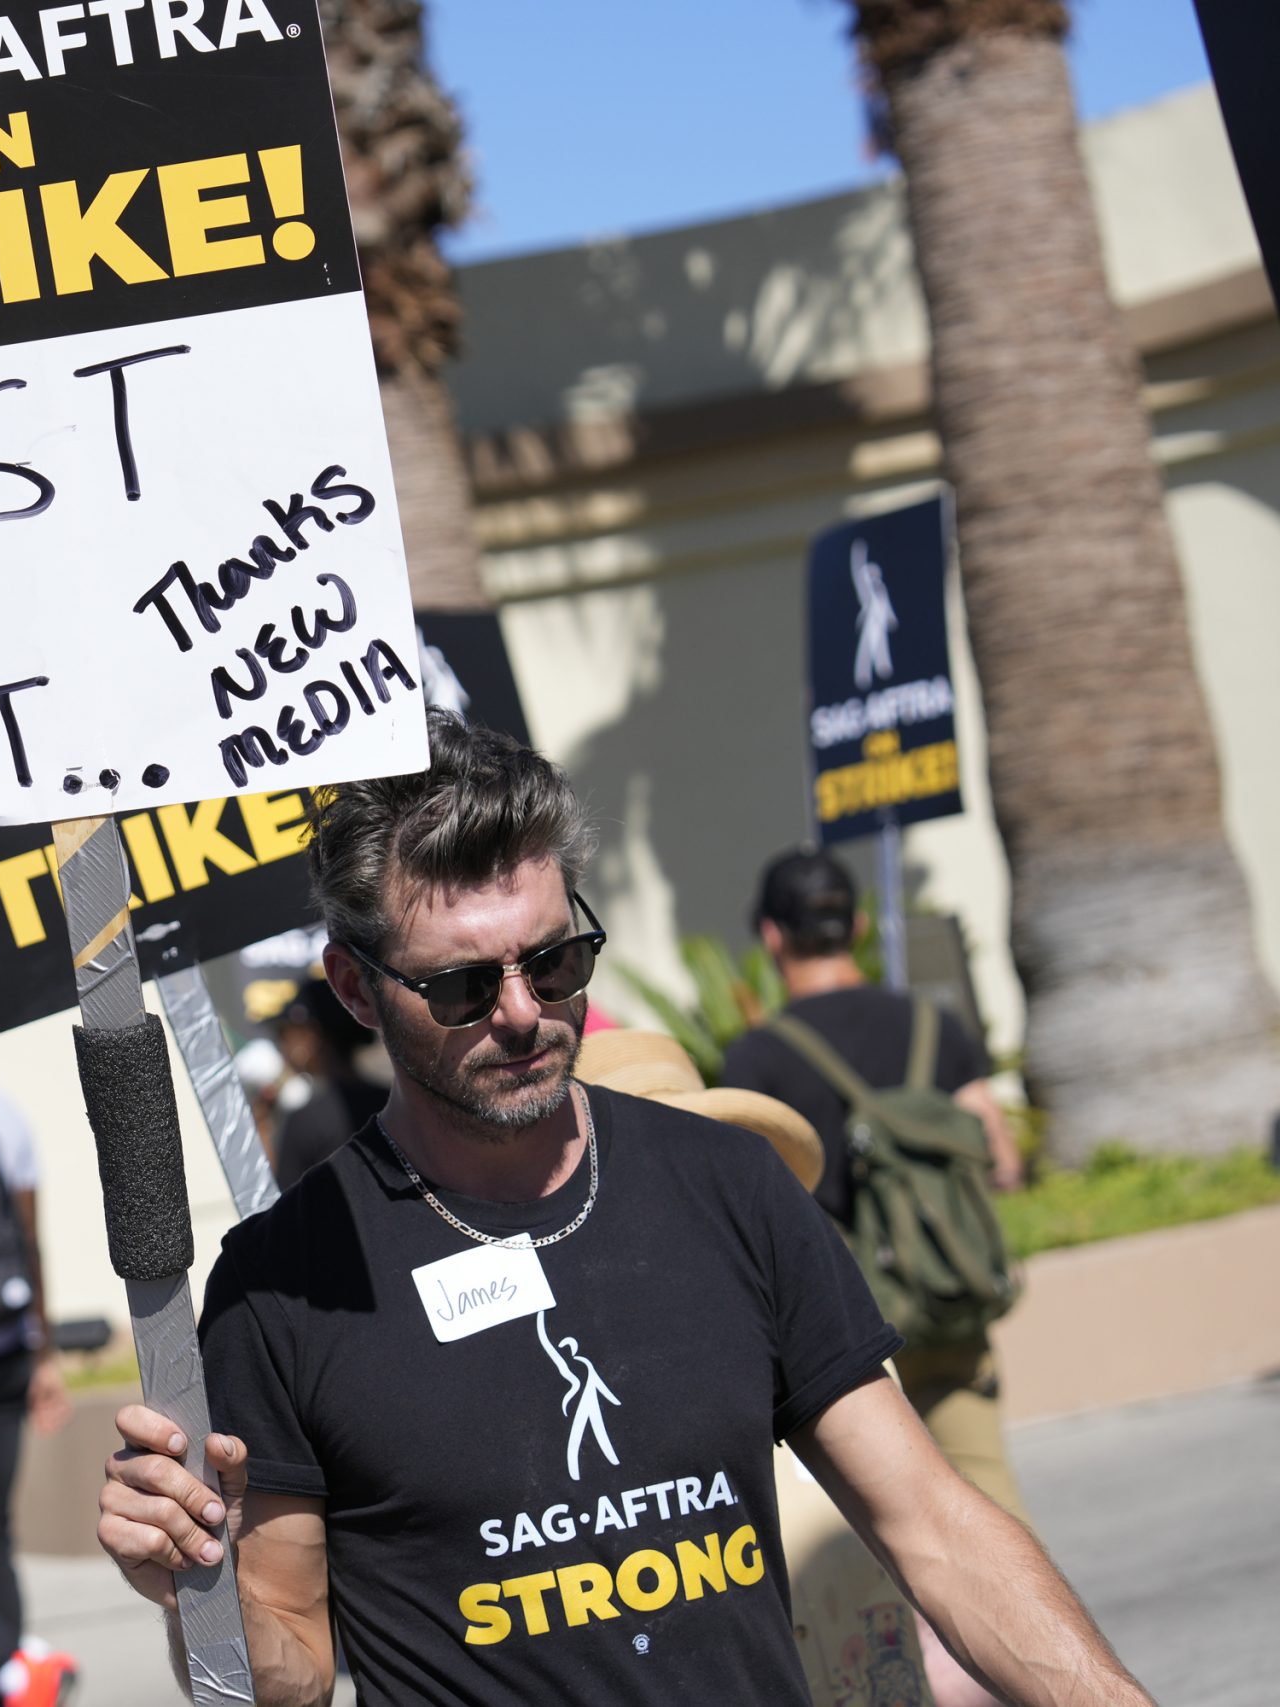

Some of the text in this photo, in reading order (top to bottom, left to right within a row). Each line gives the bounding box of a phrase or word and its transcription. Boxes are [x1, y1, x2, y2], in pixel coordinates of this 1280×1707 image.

[211, 572, 358, 720] NEW
[218, 639, 418, 788] MEDIA
[437, 1277, 518, 1321] James
[458, 1525, 765, 1645] STRONG
